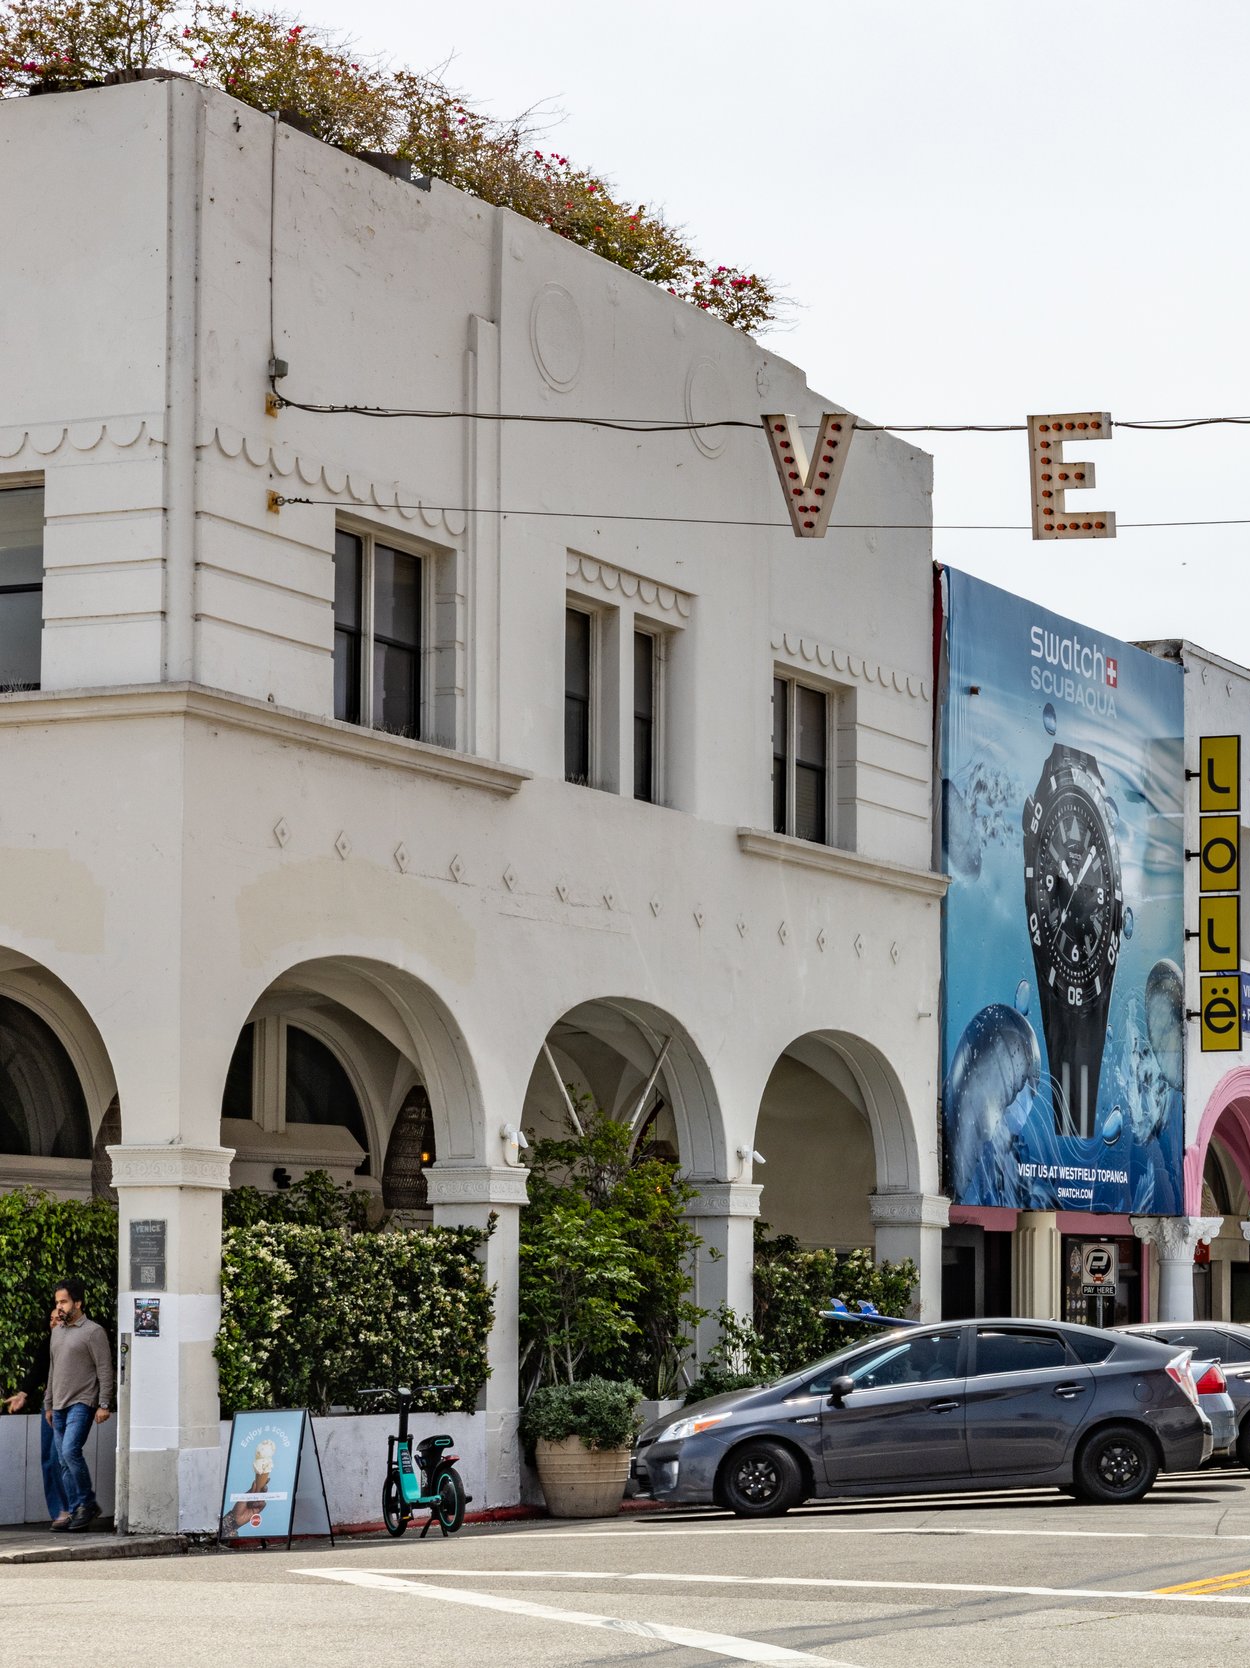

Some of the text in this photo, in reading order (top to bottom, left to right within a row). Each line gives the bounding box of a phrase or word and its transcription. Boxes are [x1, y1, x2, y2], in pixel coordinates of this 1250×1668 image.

[1030, 626, 1105, 684] swatch
[1030, 666, 1118, 719] SCUBAQUA
[1046, 874, 1054, 892] 9
[1097, 887, 1105, 905] 3
[1071, 944, 1080, 962] 6
[1067, 985, 1083, 1006] 30
[1018, 1163, 1128, 1184] VISIT US AT WESTFIELD TOPANGA
[1057, 1187, 1093, 1200] SWATCH.COM
[135, 1224, 161, 1234] VENICE
[1083, 1286, 1114, 1294] PAY HERE
[240, 1425, 263, 1449] Enjoy
[271, 1427, 291, 1448] scoop
